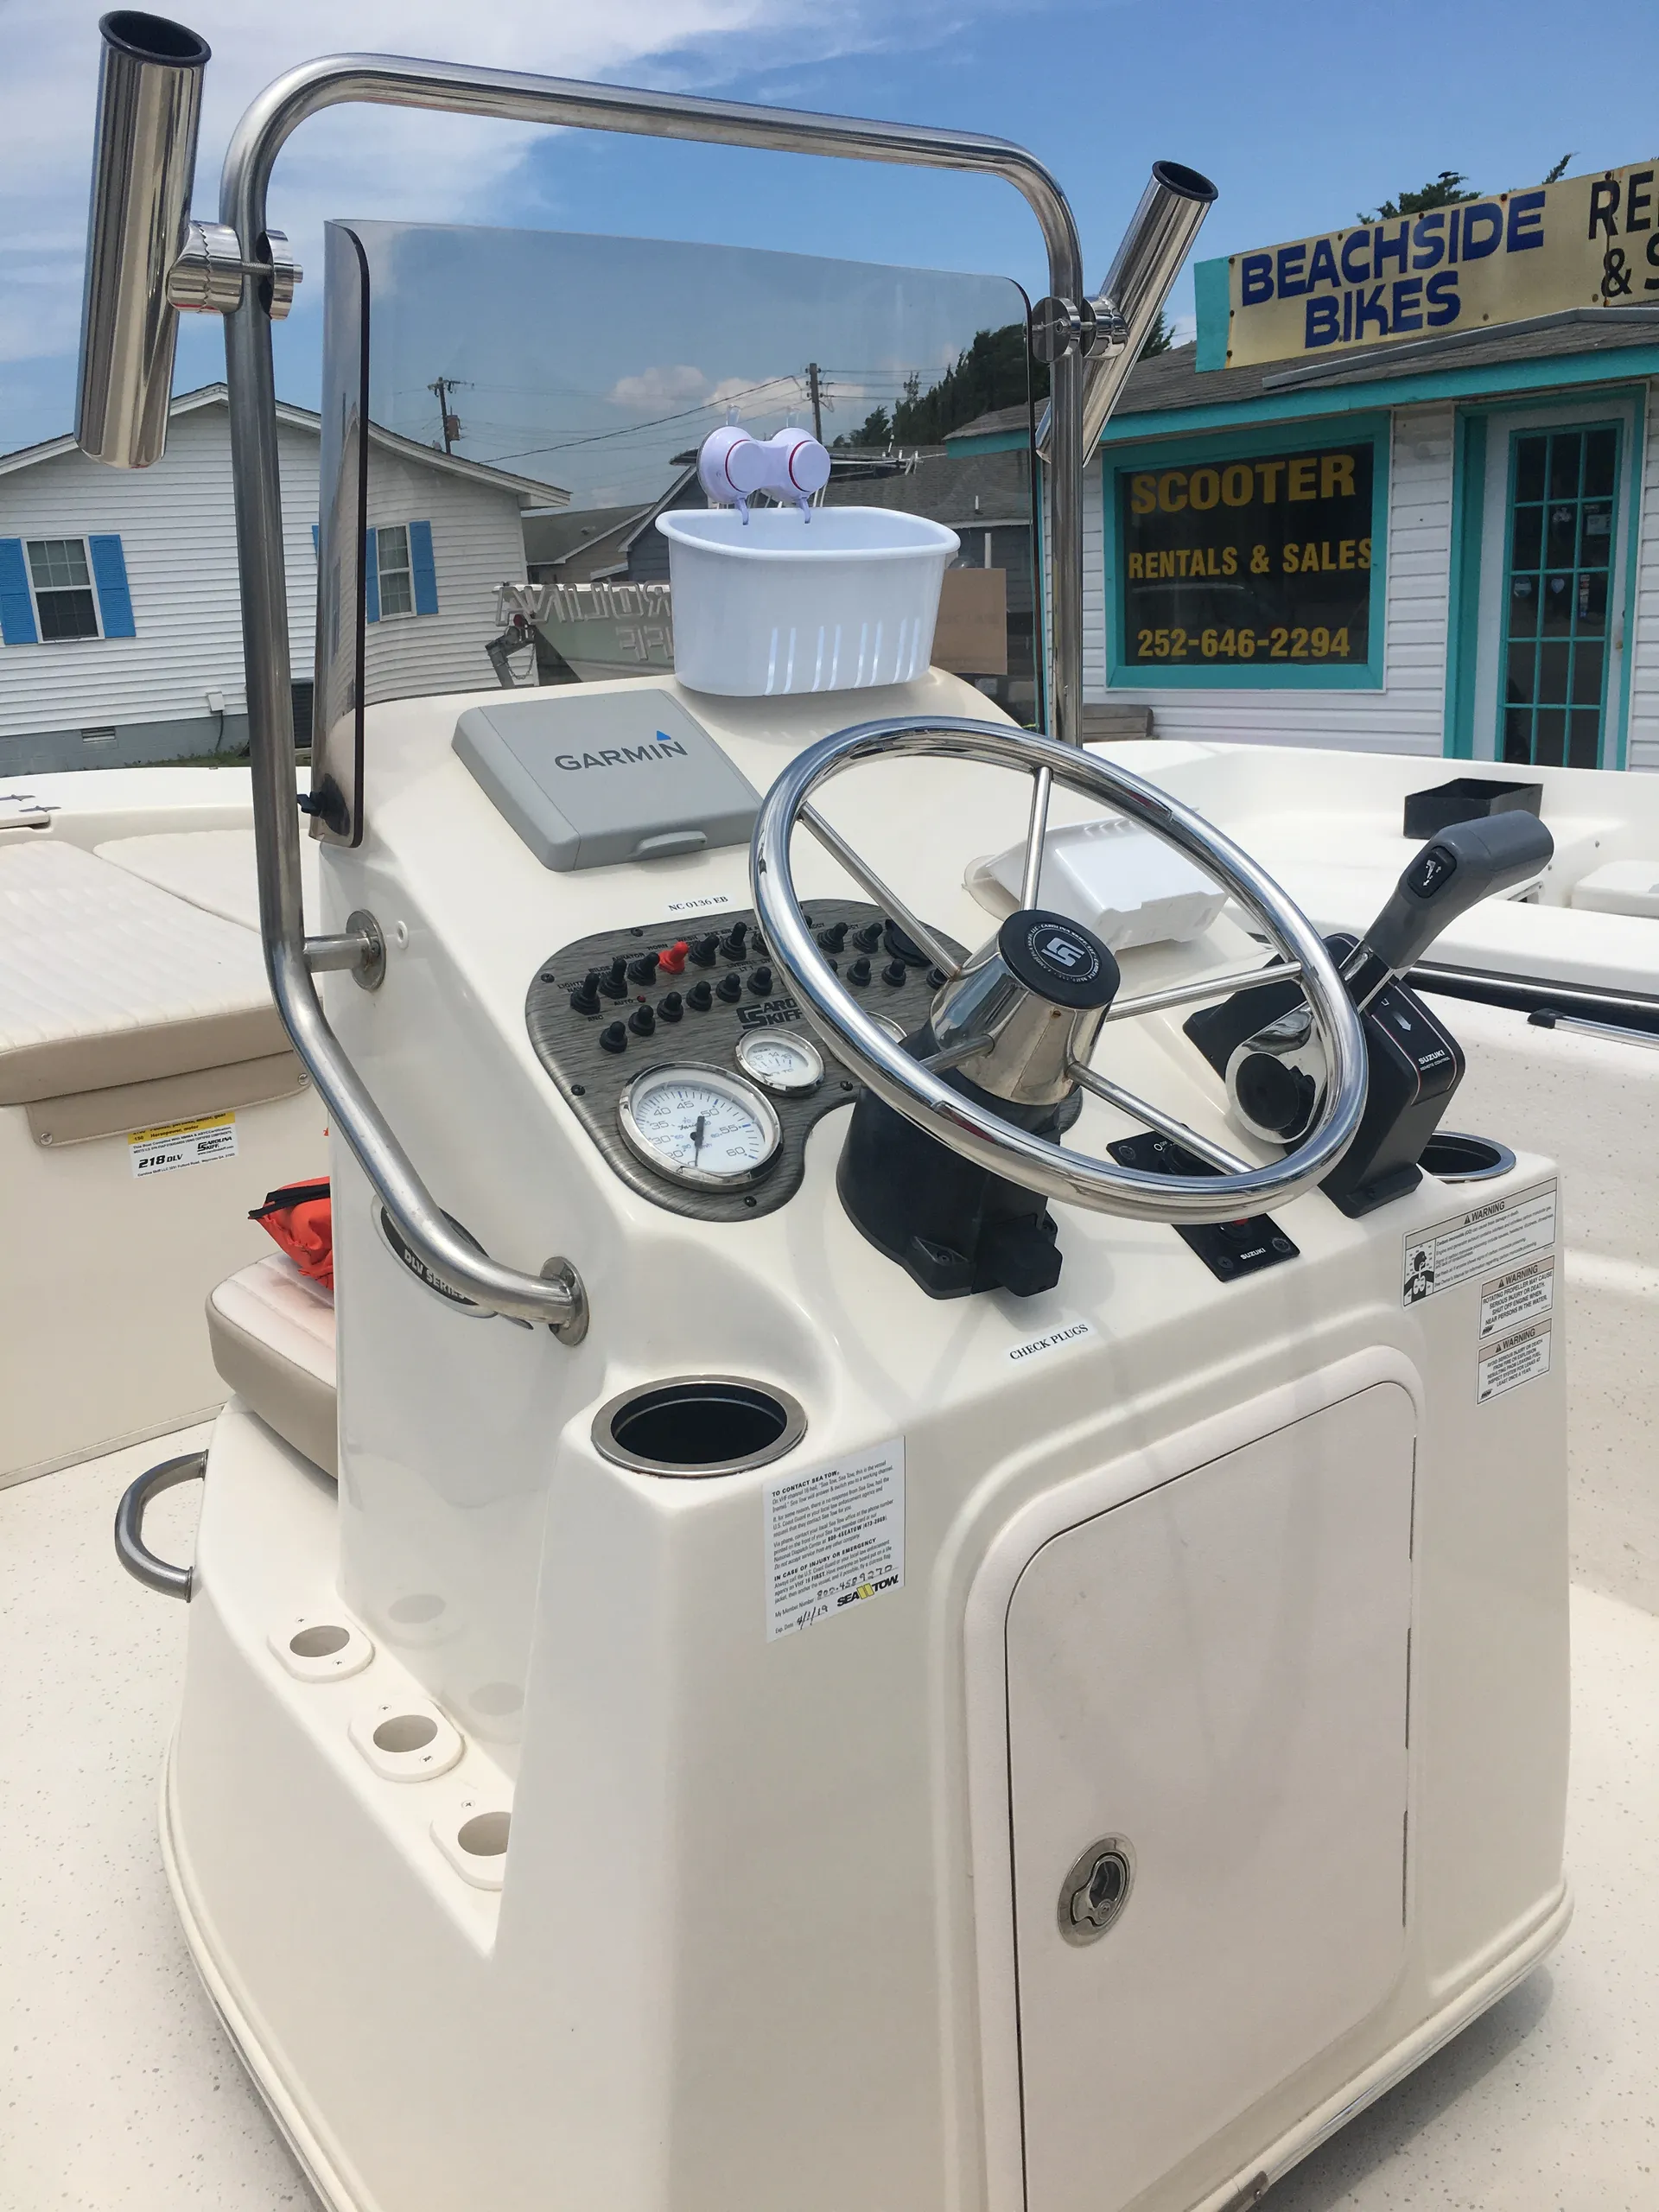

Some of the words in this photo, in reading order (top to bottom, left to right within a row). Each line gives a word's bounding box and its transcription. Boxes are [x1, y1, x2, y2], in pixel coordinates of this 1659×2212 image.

[1588, 169, 1659, 239] RE
[1242, 190, 1546, 307] BEACHSIDE
[1601, 248, 1632, 297] &
[1305, 270, 1461, 348] BIKES
[1131, 454, 1356, 514] SCOOTER
[1128, 547, 1237, 579] RENTALS
[1250, 544, 1270, 574] &
[1282, 537, 1372, 573] SALES
[1137, 626, 1351, 658] 252-646-2294
[555, 741, 688, 771] GARMIN
[668, 903, 684, 912] NC
[685, 899, 712, 908] 0136
[1418, 1049, 1446, 1065] SUZUKI
[653, 1107, 671, 1116] 40
[677, 1100, 695, 1109] 45
[700, 1108, 720, 1118] 50
[650, 1120, 670, 1130] 35
[719, 1124, 738, 1135] 55
[196, 1136, 232, 1149] CAROLINA
[652, 1135, 671, 1146] 30
[726, 1147, 746, 1157] 60
[137, 1154, 166, 1168] 218
[166, 1153, 183, 1162] DLV
[1471, 1200, 1504, 1222] WARNING
[404, 1249, 424, 1275] DLV
[1240, 1247, 1266, 1261] SUZUKI
[1504, 1263, 1538, 1286] WARNING
[1482, 1290, 1503, 1305] ROTATING
[1503, 1280, 1528, 1296] PROPELLER
[1529, 1275, 1537, 1285] MAY
[1538, 1269, 1552, 1281] CAUSE
[1489, 1295, 1507, 1309] SERIOUS
[1508, 1289, 1522, 1301] INJURY
[1523, 1286, 1529, 1294] OR
[1530, 1280, 1545, 1292] DEATH.
[1484, 1315, 1497, 1326] NEAR
[1497, 1306, 1517, 1320] PERSONS
[1532, 1294, 1548, 1306] WATER.
[1491, 1305, 1503, 1316] SHUT
[1503, 1301, 1512, 1311] OFF
[1512, 1294, 1529, 1306] ENGINE
[1529, 1288, 1541, 1300] WHEN
[1009, 1338, 1051, 1360] CHECK
[1050, 1324, 1089, 1344] PLUGS
[1502, 1326, 1535, 1350] WARNING
[782, 1479, 810, 1494] CONTACT
[811, 1475, 823, 1484] SEA
[782, 1567, 798, 1578] CASE
[809, 1554, 830, 1567] INJURY
[842, 1537, 876, 1555] EMERGENCY
[836, 1589, 860, 1608] SEA
